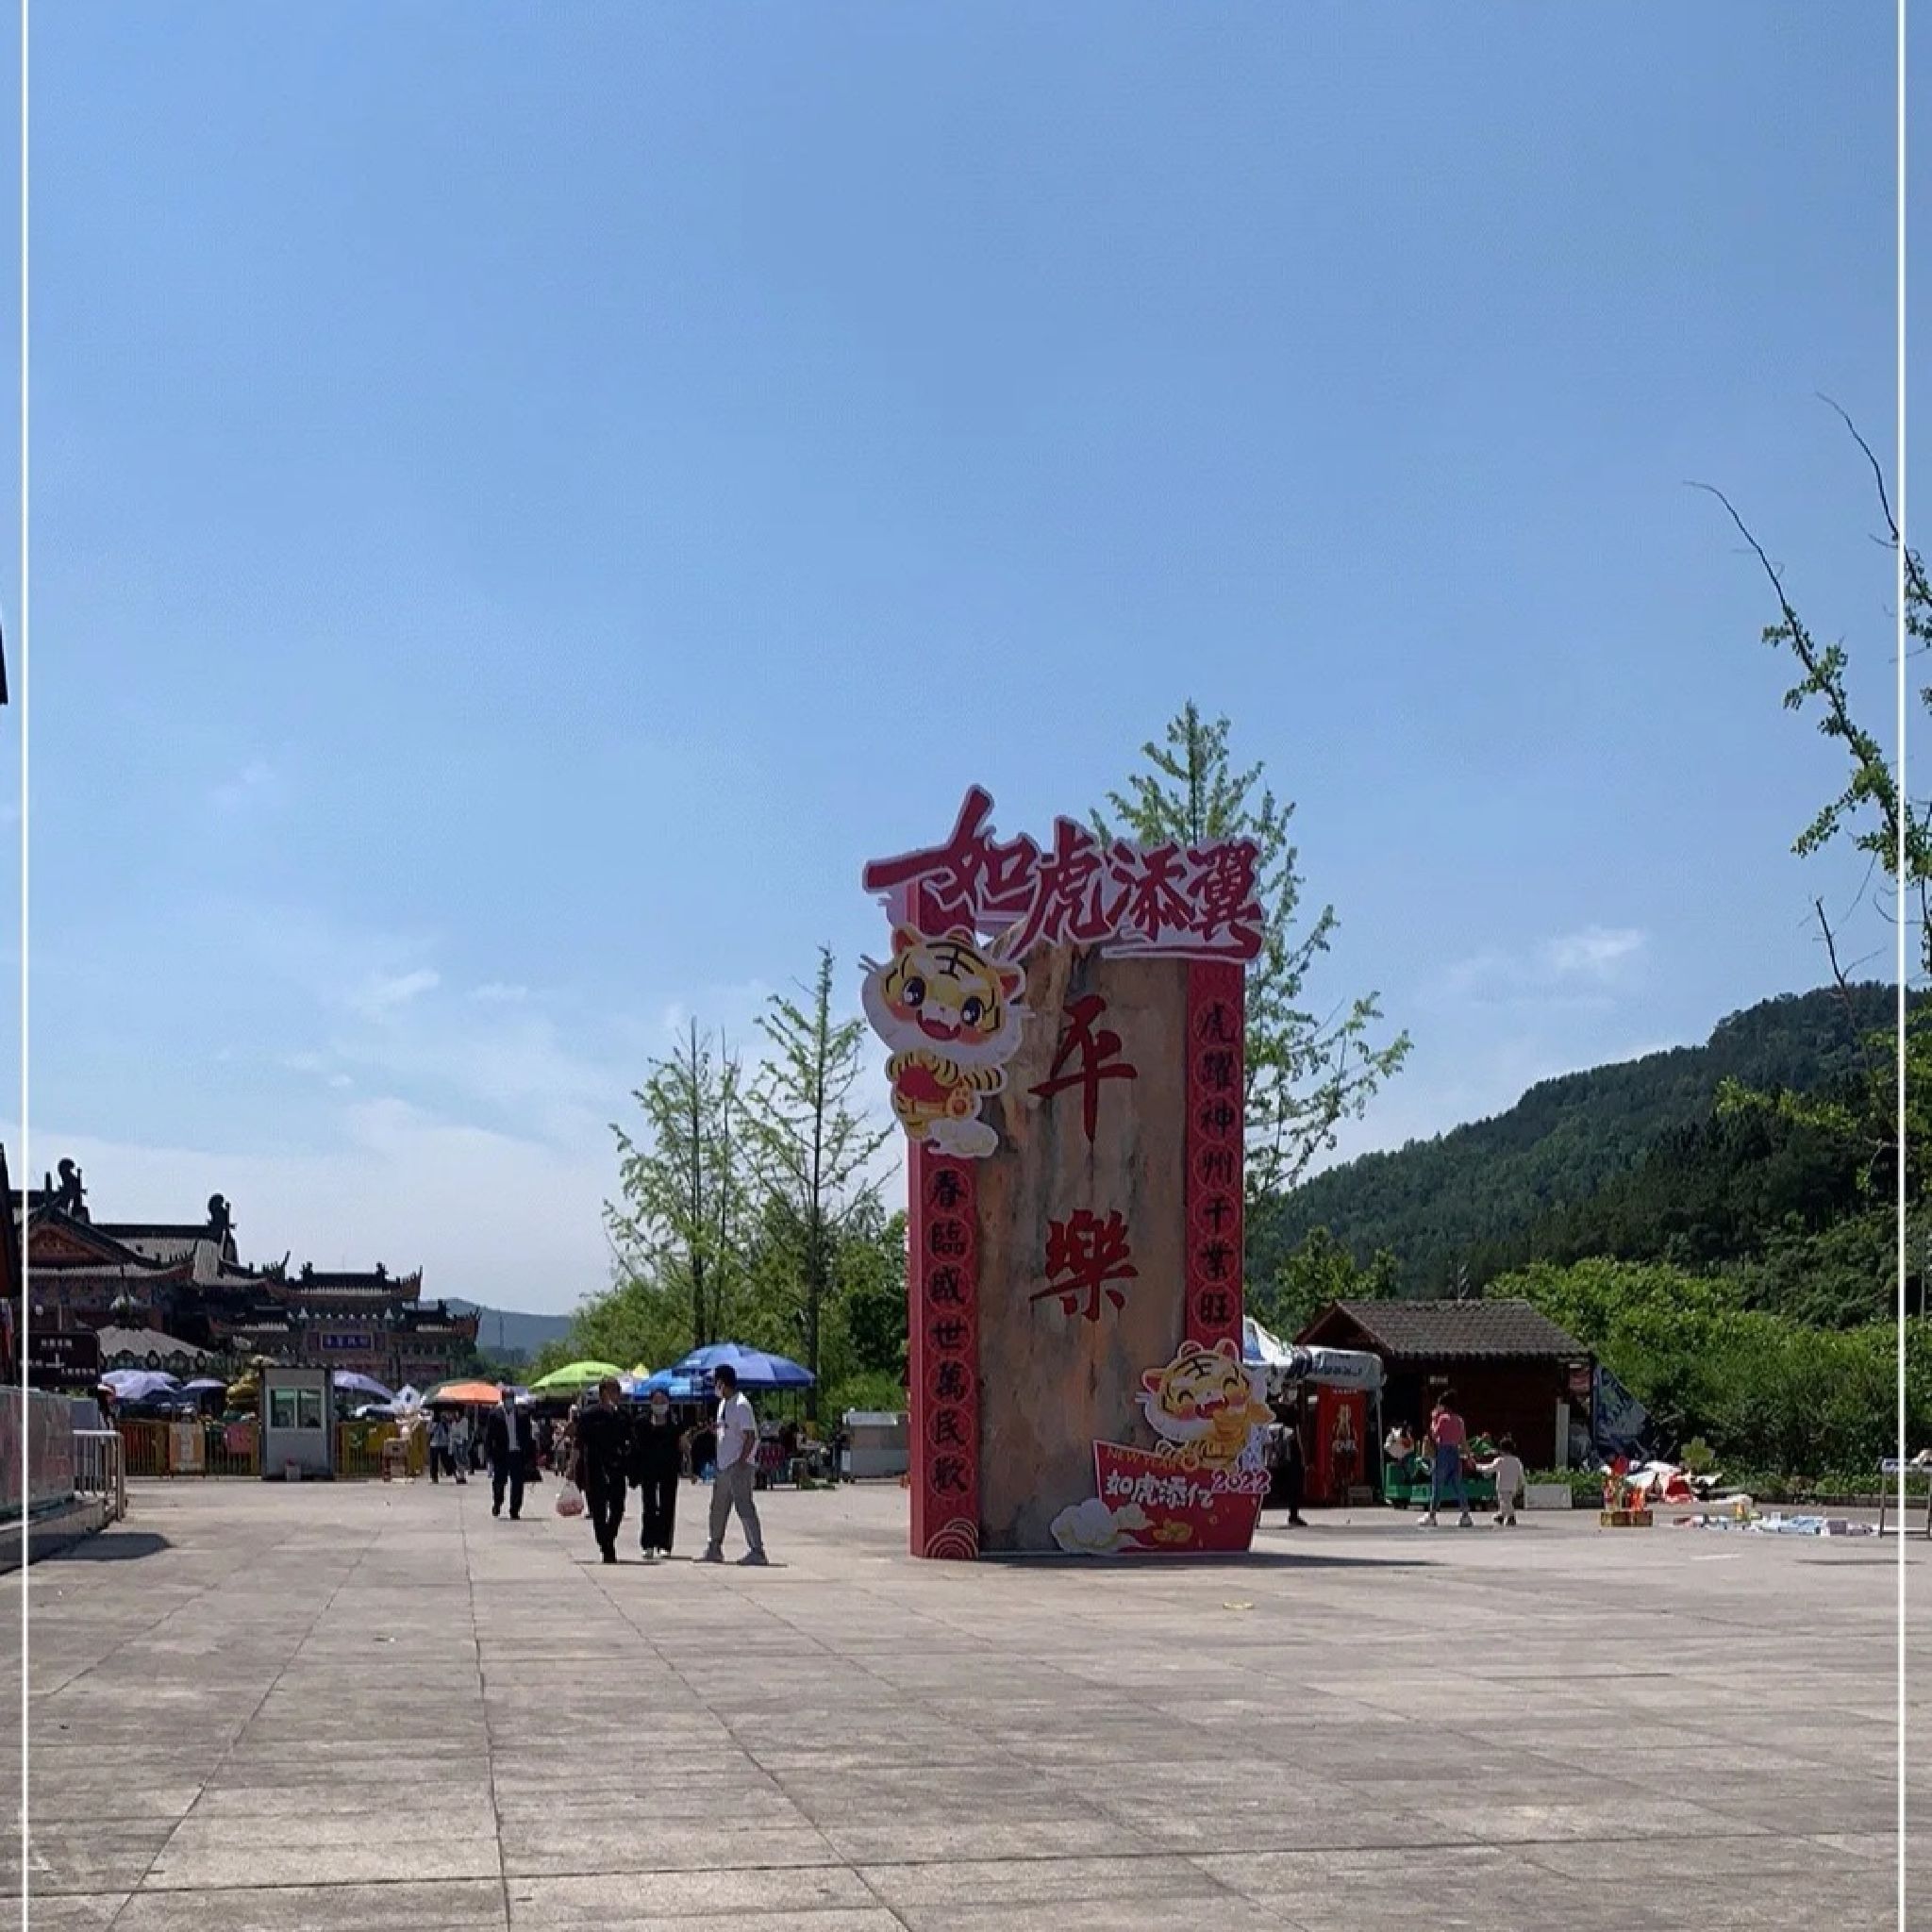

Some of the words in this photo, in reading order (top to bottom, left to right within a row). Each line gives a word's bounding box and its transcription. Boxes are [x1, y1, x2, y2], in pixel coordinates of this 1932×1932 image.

[863, 785, 1263, 962] 如虎添翼
[1211, 1469, 1271, 1493] 2022
